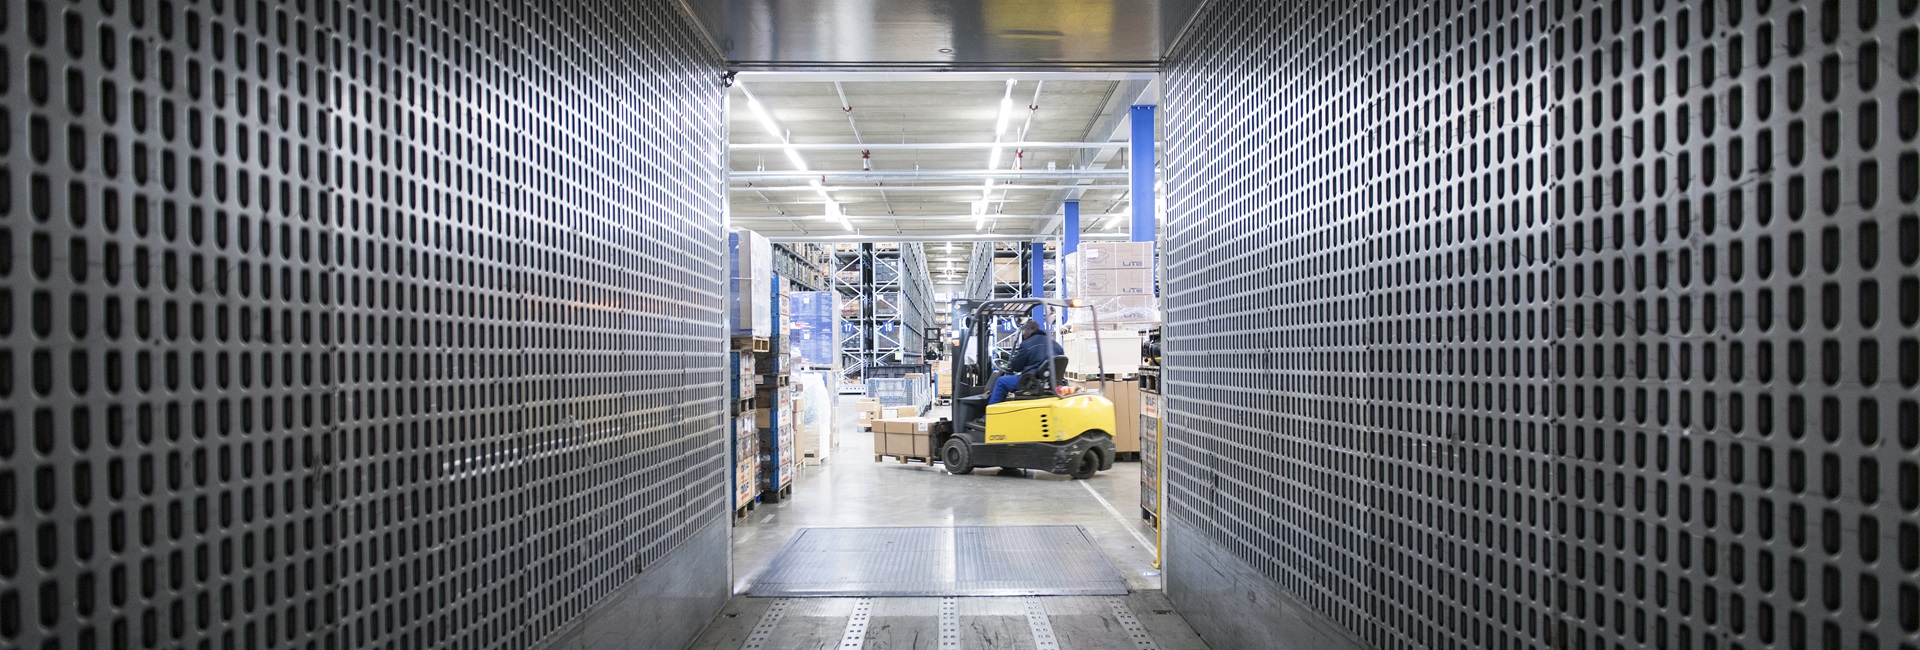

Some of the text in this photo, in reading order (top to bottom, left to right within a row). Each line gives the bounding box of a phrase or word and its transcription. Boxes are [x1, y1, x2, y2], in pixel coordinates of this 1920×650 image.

[844, 323, 852, 332] 17
[884, 323, 893, 332] 18
[1003, 322, 1012, 331] 18
